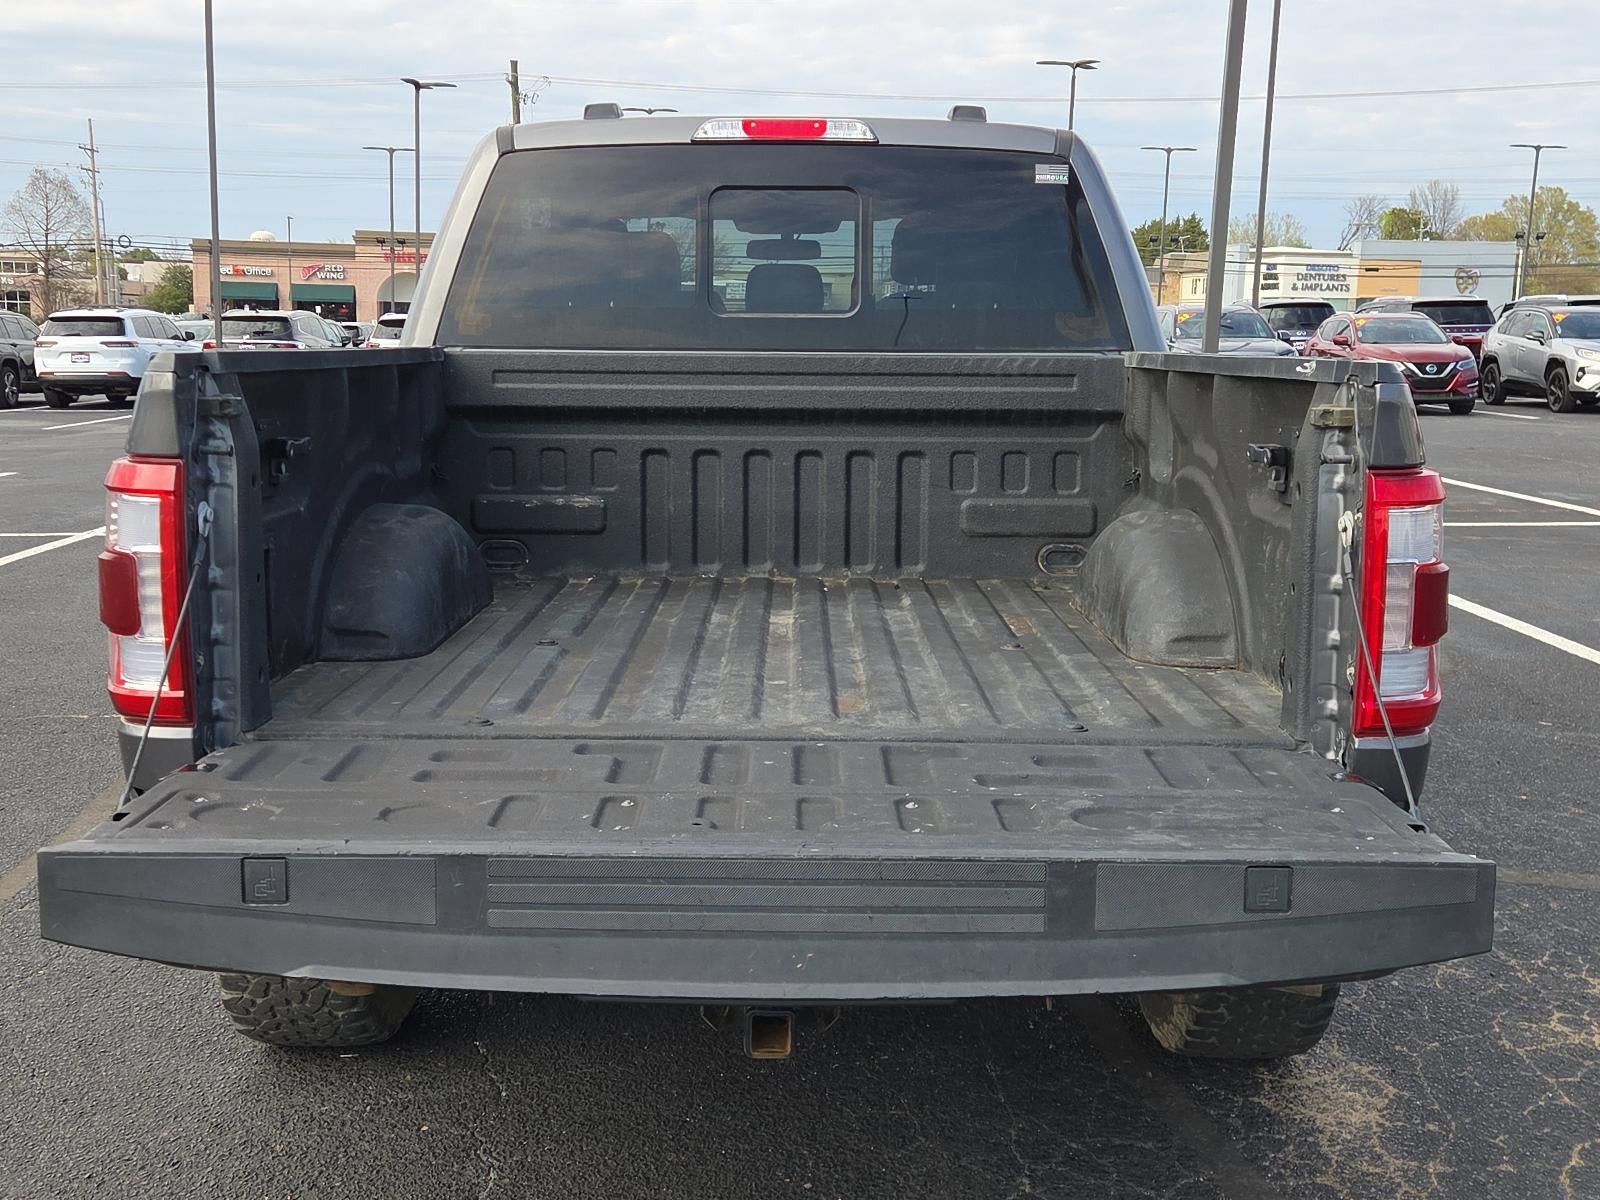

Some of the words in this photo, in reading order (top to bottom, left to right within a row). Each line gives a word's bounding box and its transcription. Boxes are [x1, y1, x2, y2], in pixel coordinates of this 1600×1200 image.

[324, 264, 343, 272] RED
[316, 271, 344, 279] WING
[1296, 273, 1347, 282] DENTURES
[1301, 283, 1350, 292] IMPLANTS
